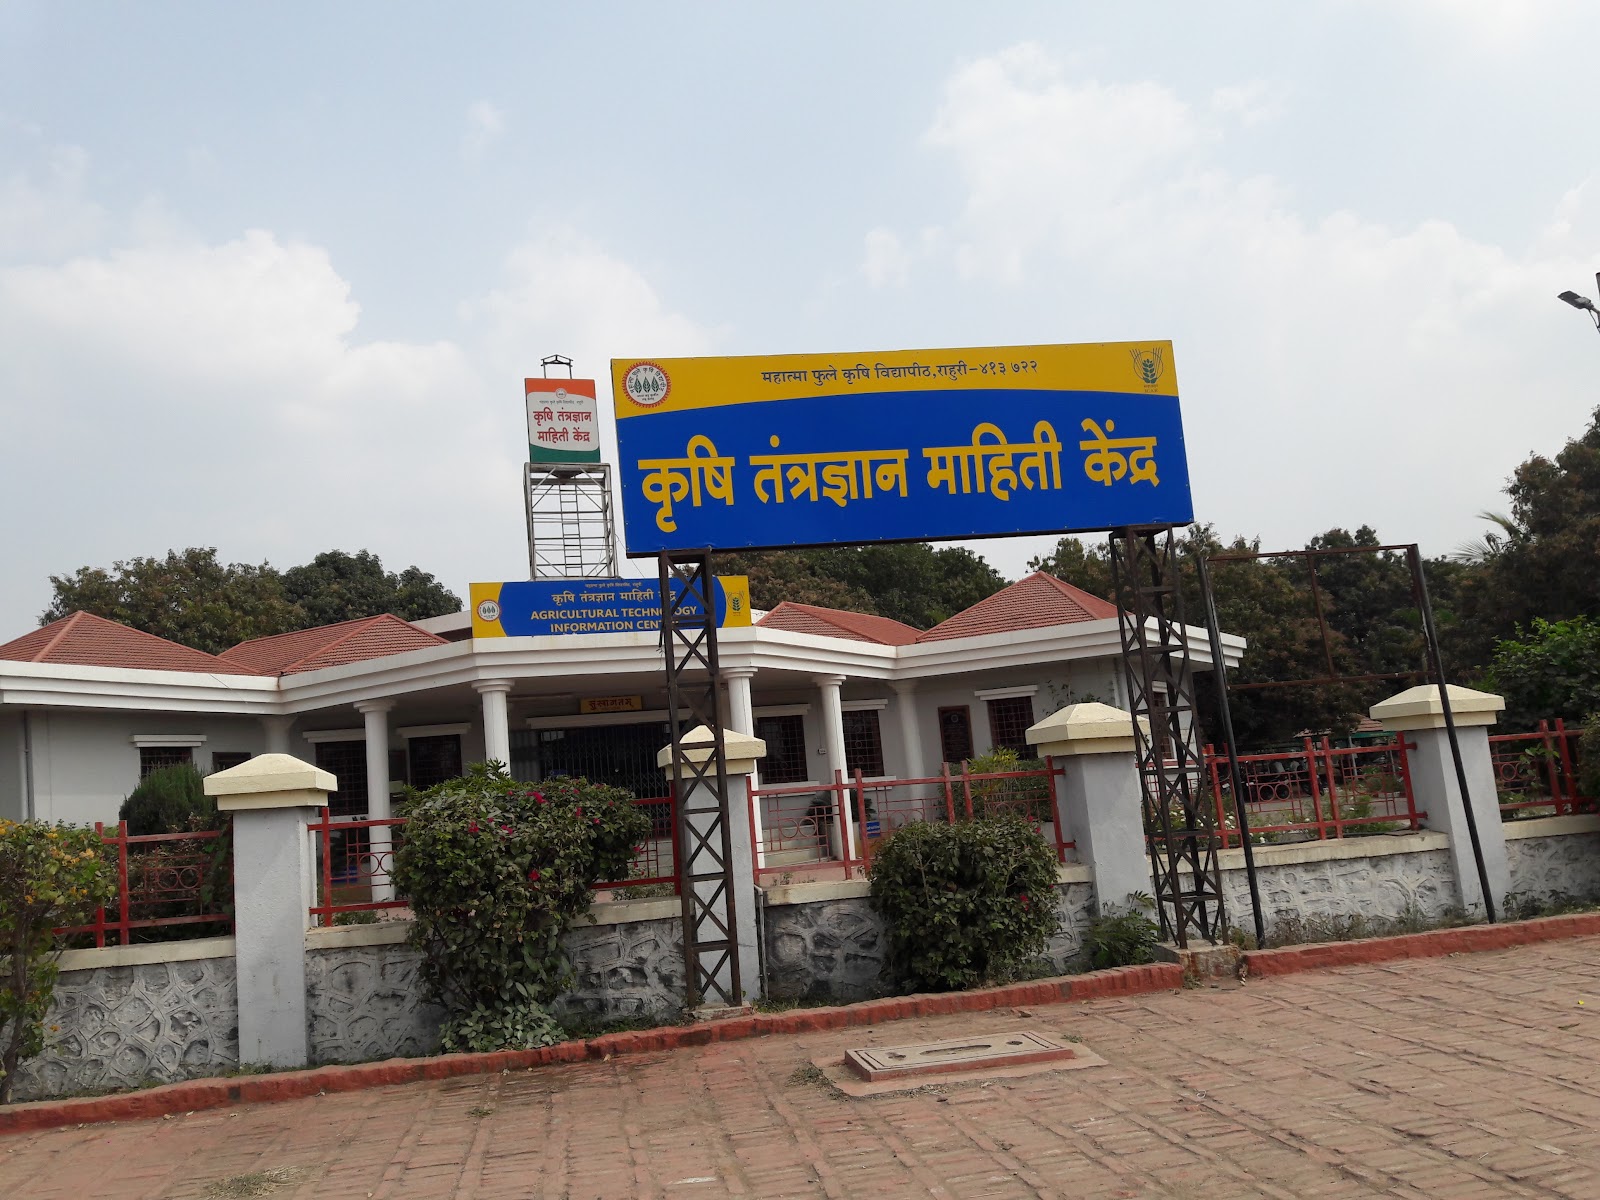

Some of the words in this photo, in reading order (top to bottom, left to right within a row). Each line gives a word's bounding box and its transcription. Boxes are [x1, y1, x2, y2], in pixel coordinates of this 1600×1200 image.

[761, 371, 807, 384] महात्मा
[812, 365, 837, 386] फुले
[842, 363, 870, 384] कृषि
[533, 407, 553, 426] कृषि
[557, 407, 591, 423] तंत्रज्ञान
[537, 427, 569, 443] माहिती
[573, 427, 590, 442] केंद्र
[638, 434, 735, 533] कृषि
[749, 435, 909, 507] तंत्रज्ञान
[922, 420, 1062, 501] माहिती
[1080, 418, 1160, 488] केंद्र
[551, 590, 575, 606] कृषि
[579, 591, 615, 603] तंत्रज्ञान
[620, 589, 654, 602] माहिती
[531, 608, 619, 620] AGRICULTURAL
[621, 606, 697, 617] TECHNOGY
[551, 621, 633, 633] INFORMATION
